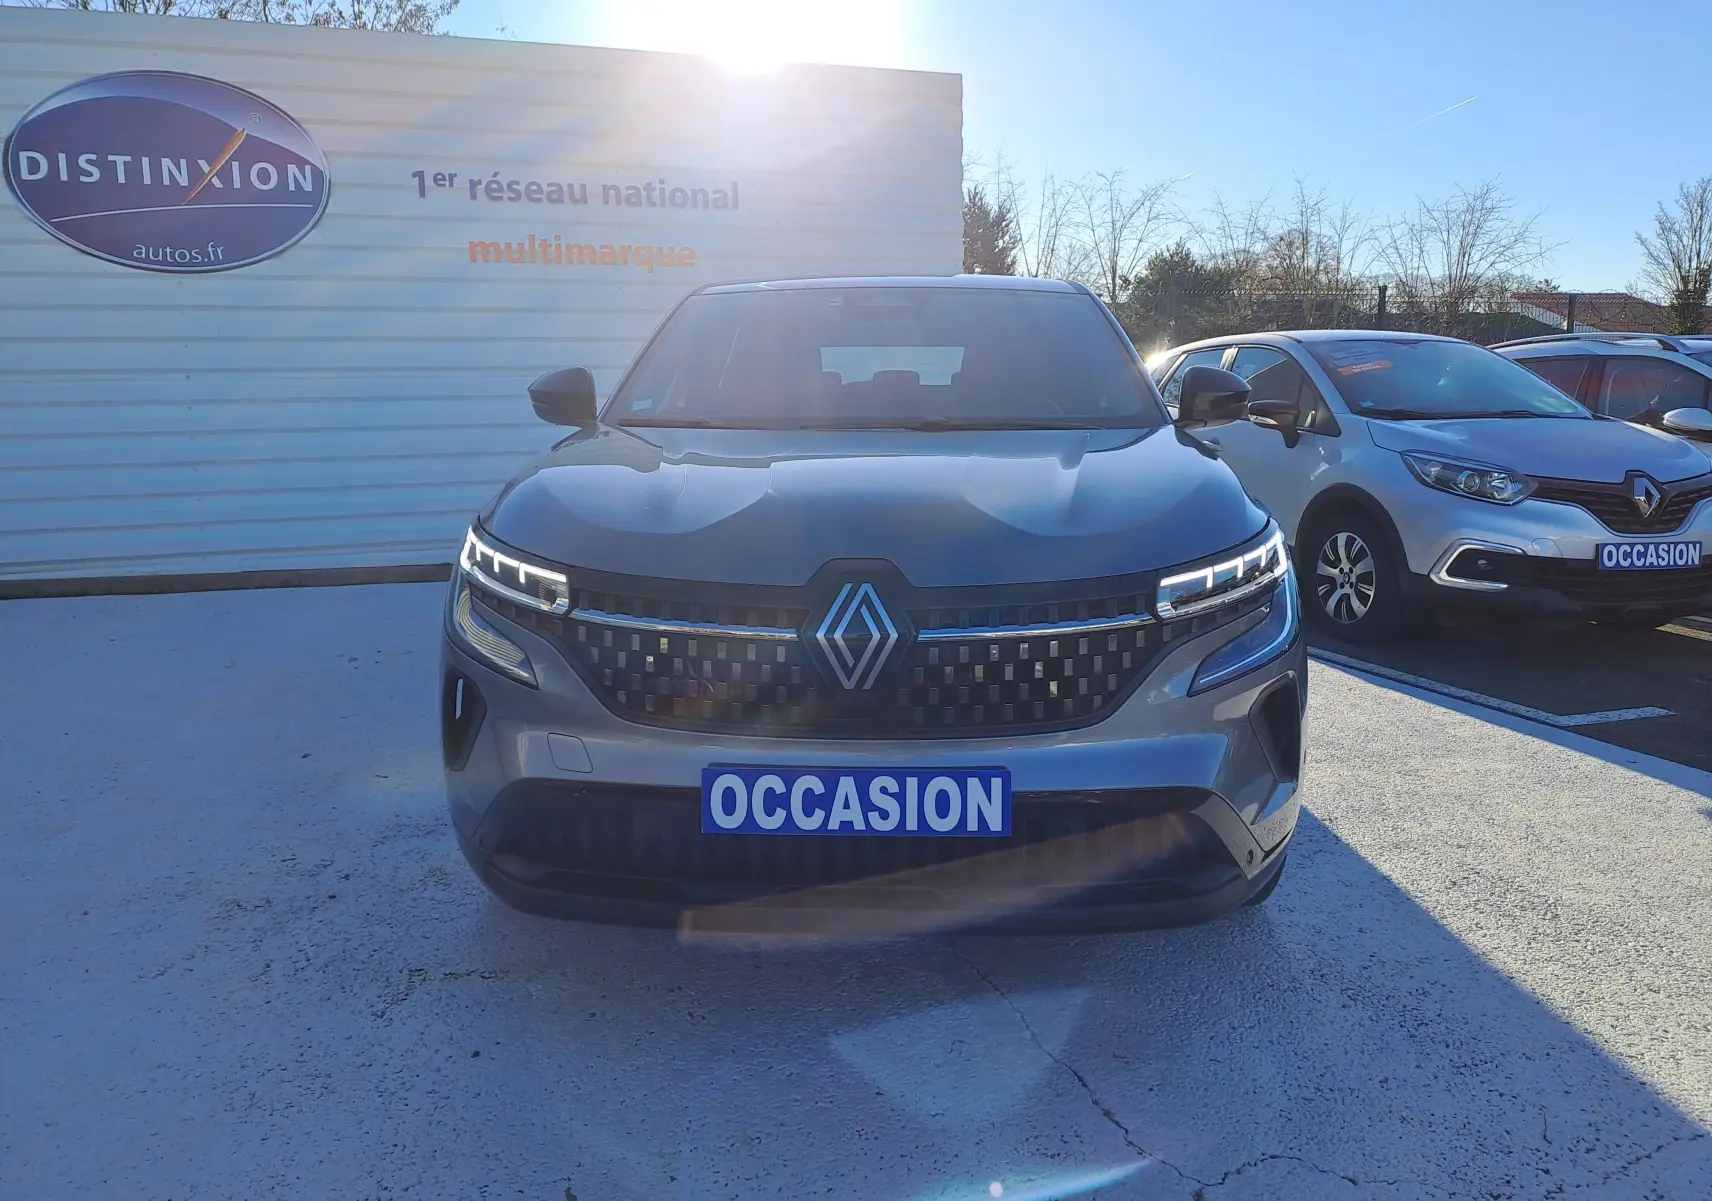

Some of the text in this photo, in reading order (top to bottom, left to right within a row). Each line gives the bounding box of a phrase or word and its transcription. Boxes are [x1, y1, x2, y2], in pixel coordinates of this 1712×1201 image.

[19, 149, 313, 194] DISTINXION
[411, 170, 739, 210] 1er réseau national
[133, 242, 225, 263] autos.fr
[468, 233, 696, 273] multimarque
[1603, 543, 1700, 567] OCCASION
[710, 773, 1003, 832] OCCASION
